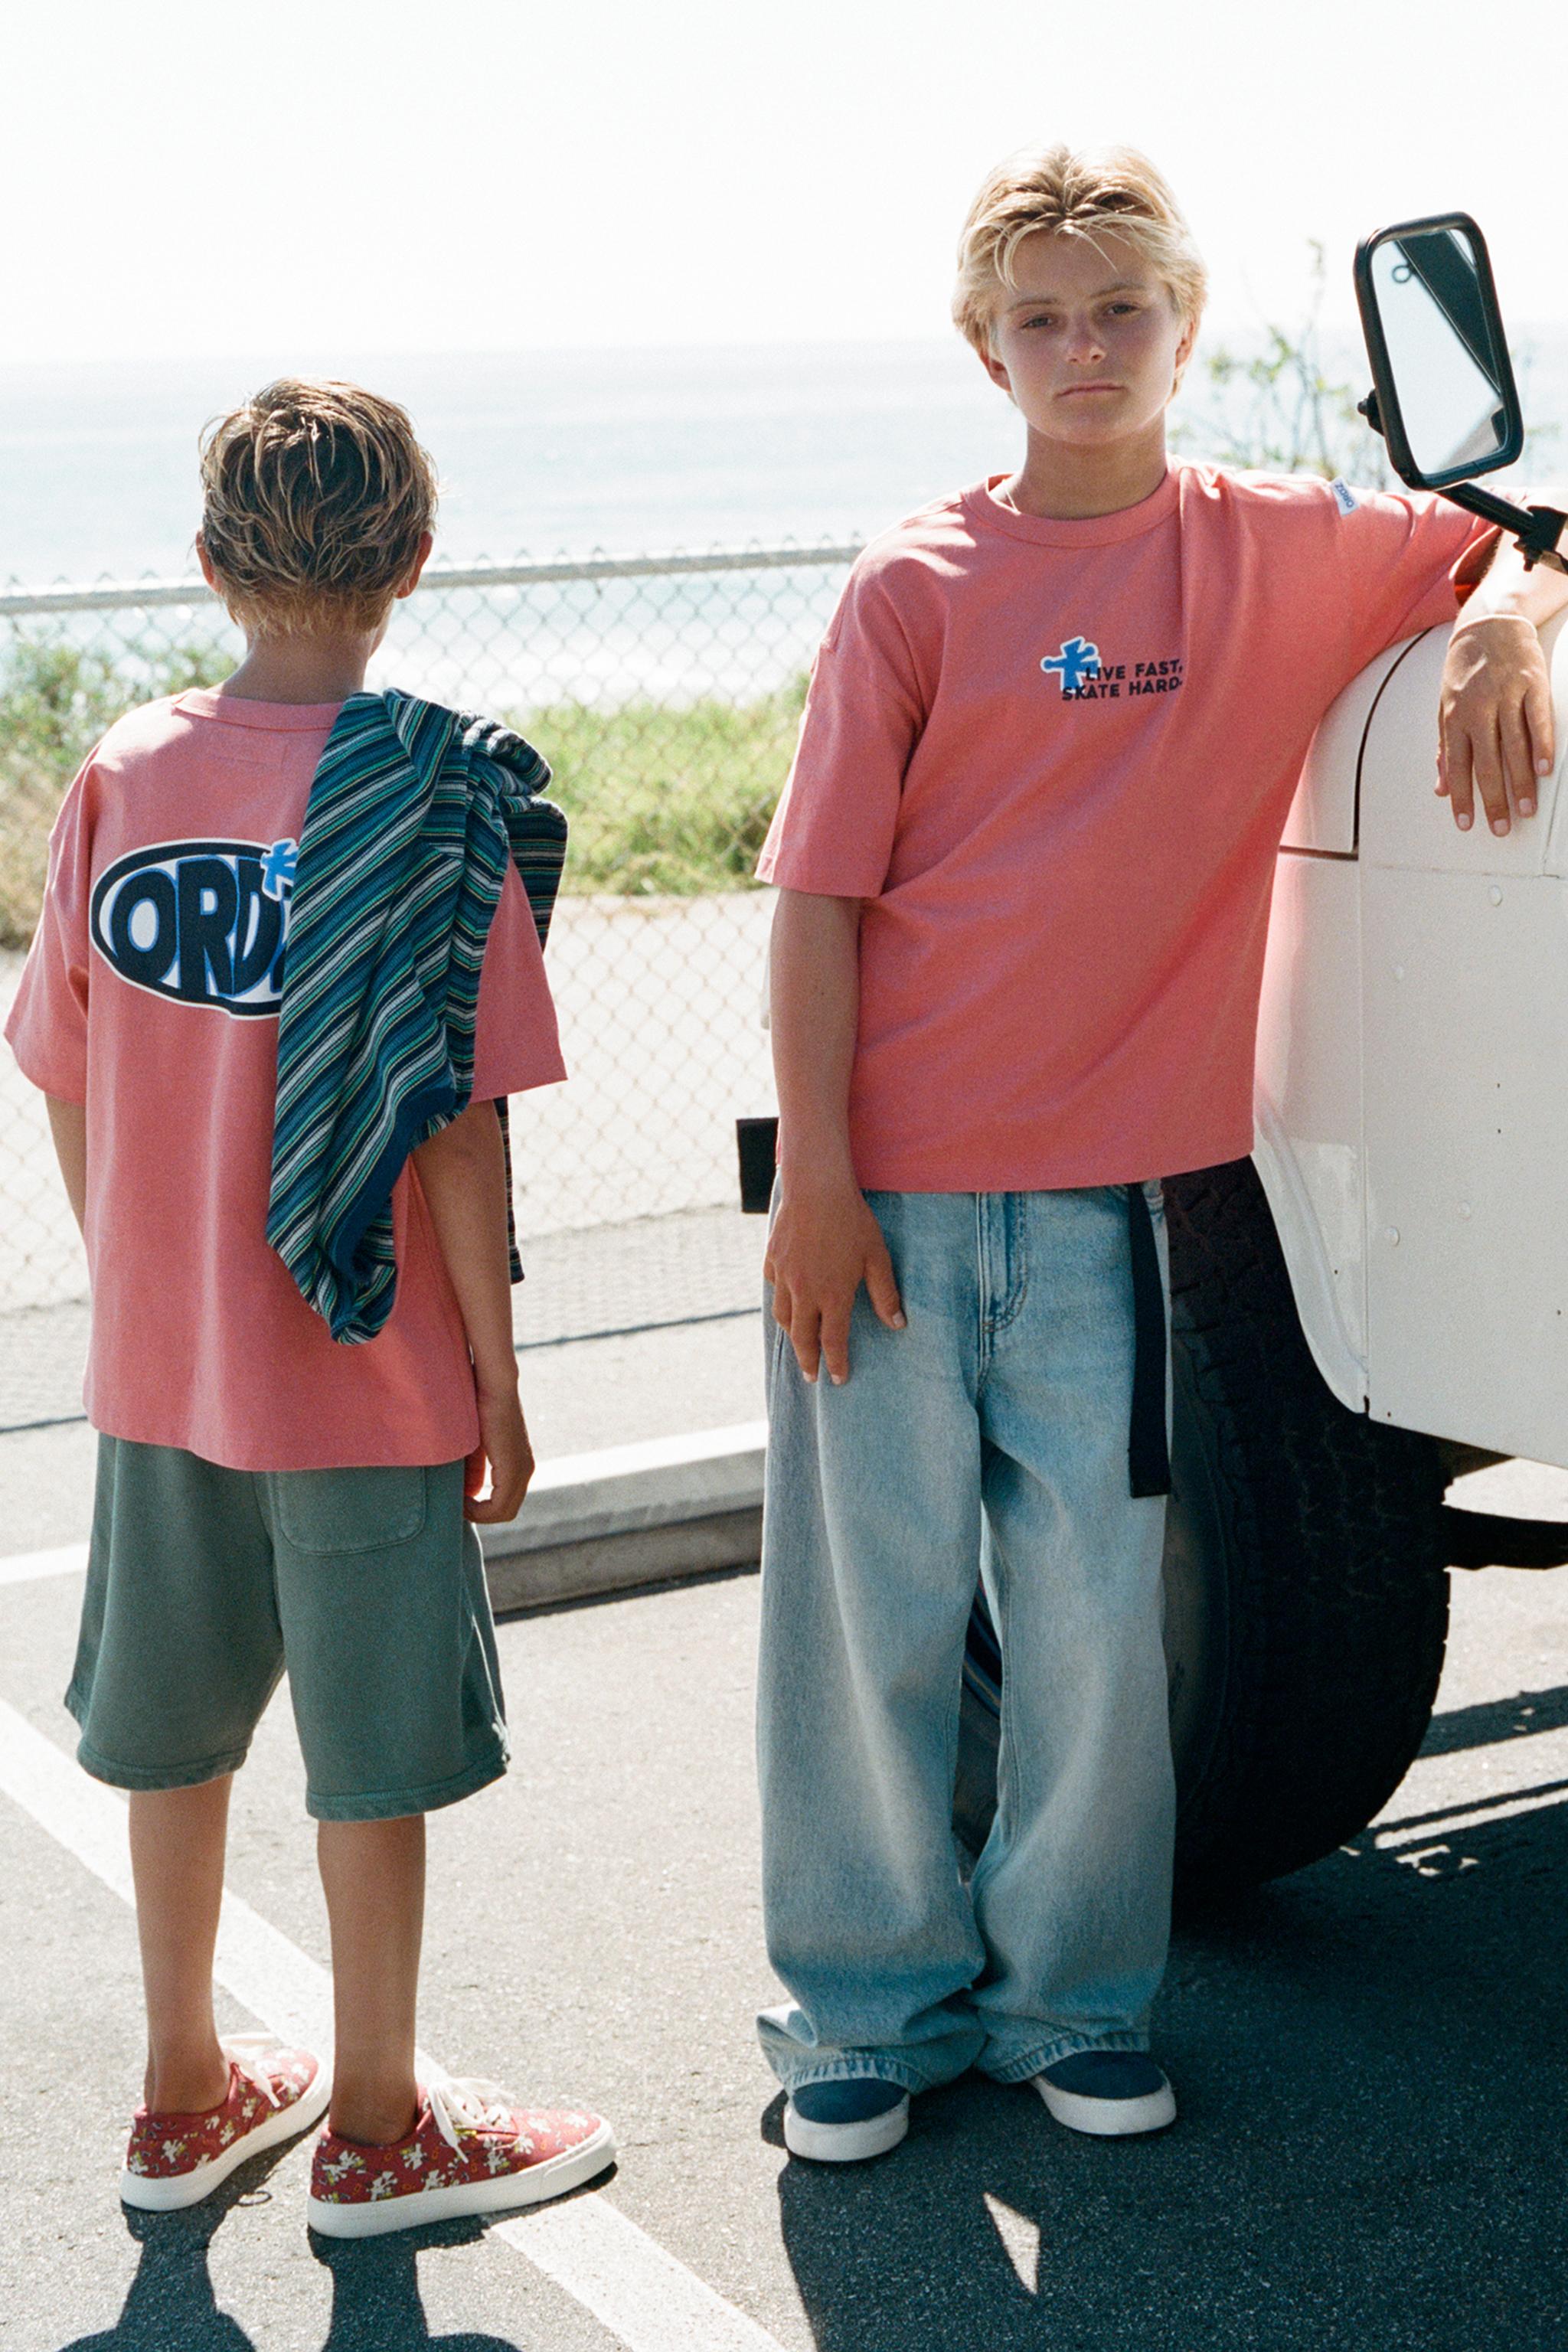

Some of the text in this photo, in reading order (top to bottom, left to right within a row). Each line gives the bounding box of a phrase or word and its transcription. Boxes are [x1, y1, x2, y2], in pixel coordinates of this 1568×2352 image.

[1086, 658, 1184, 681] LIVE FAST,
[1061, 683, 1120, 701] SKATE
[109, 854, 292, 998] ORD
